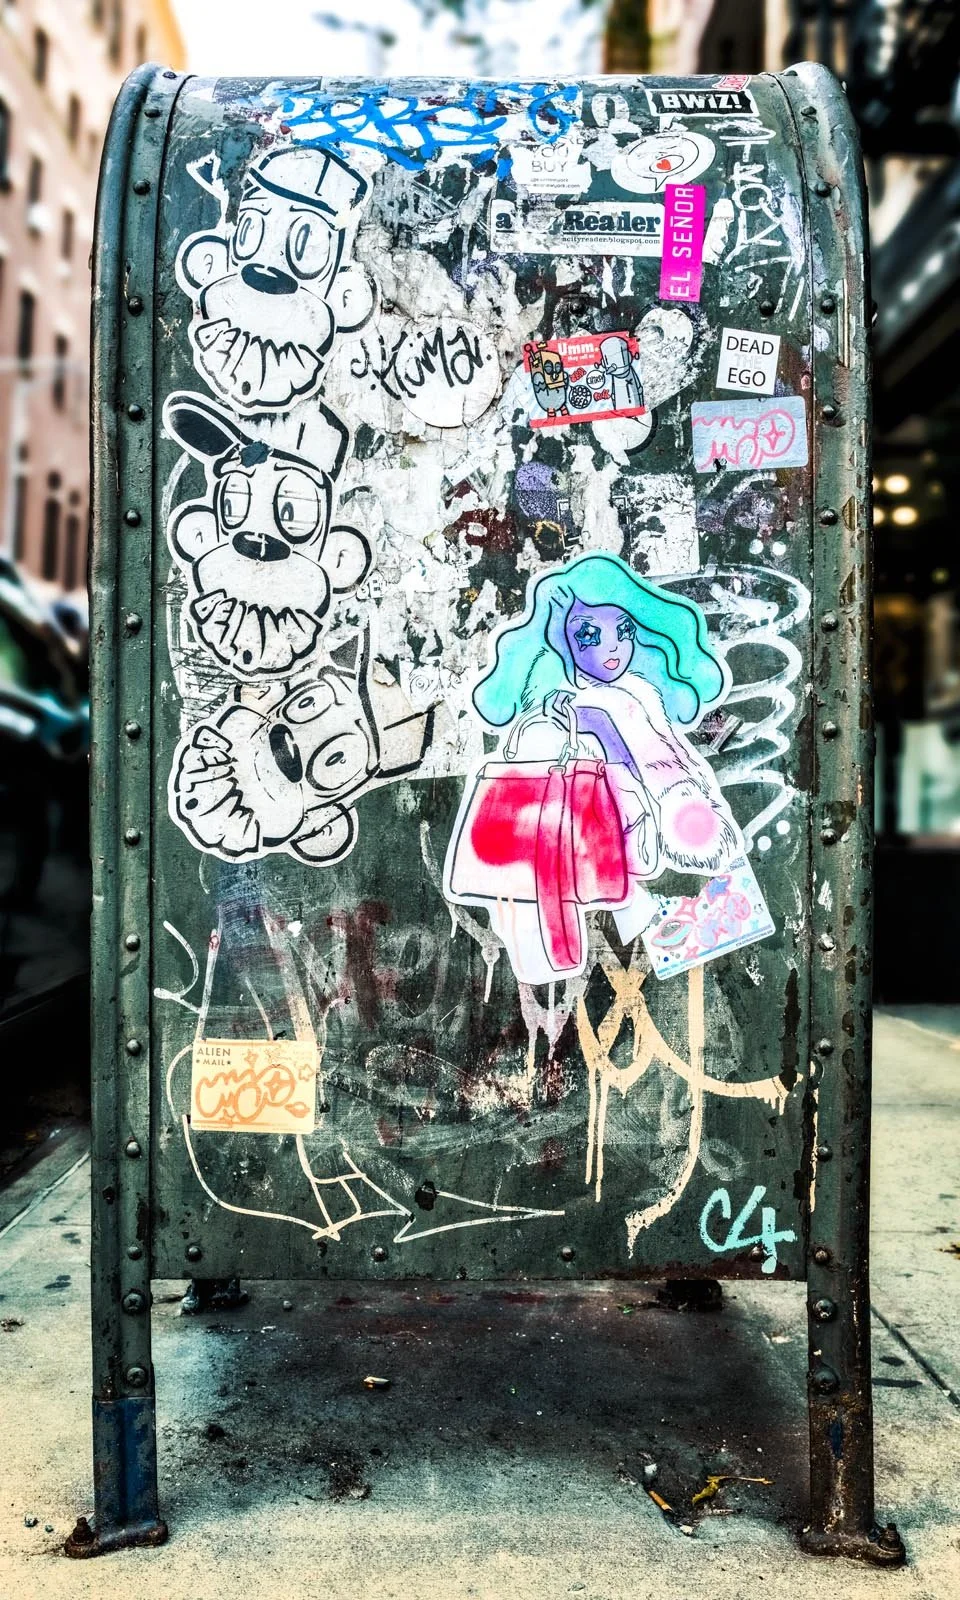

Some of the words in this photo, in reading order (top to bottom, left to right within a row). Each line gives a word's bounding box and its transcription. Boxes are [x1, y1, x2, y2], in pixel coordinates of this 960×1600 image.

[531, 160, 568, 173] BUY
[670, 187, 695, 259] SEÑOR
[670, 271, 691, 297] EL
[727, 335, 774, 355] DEAD
[728, 367, 766, 387] EGO
[196, 1047, 231, 1057] ALIEN
